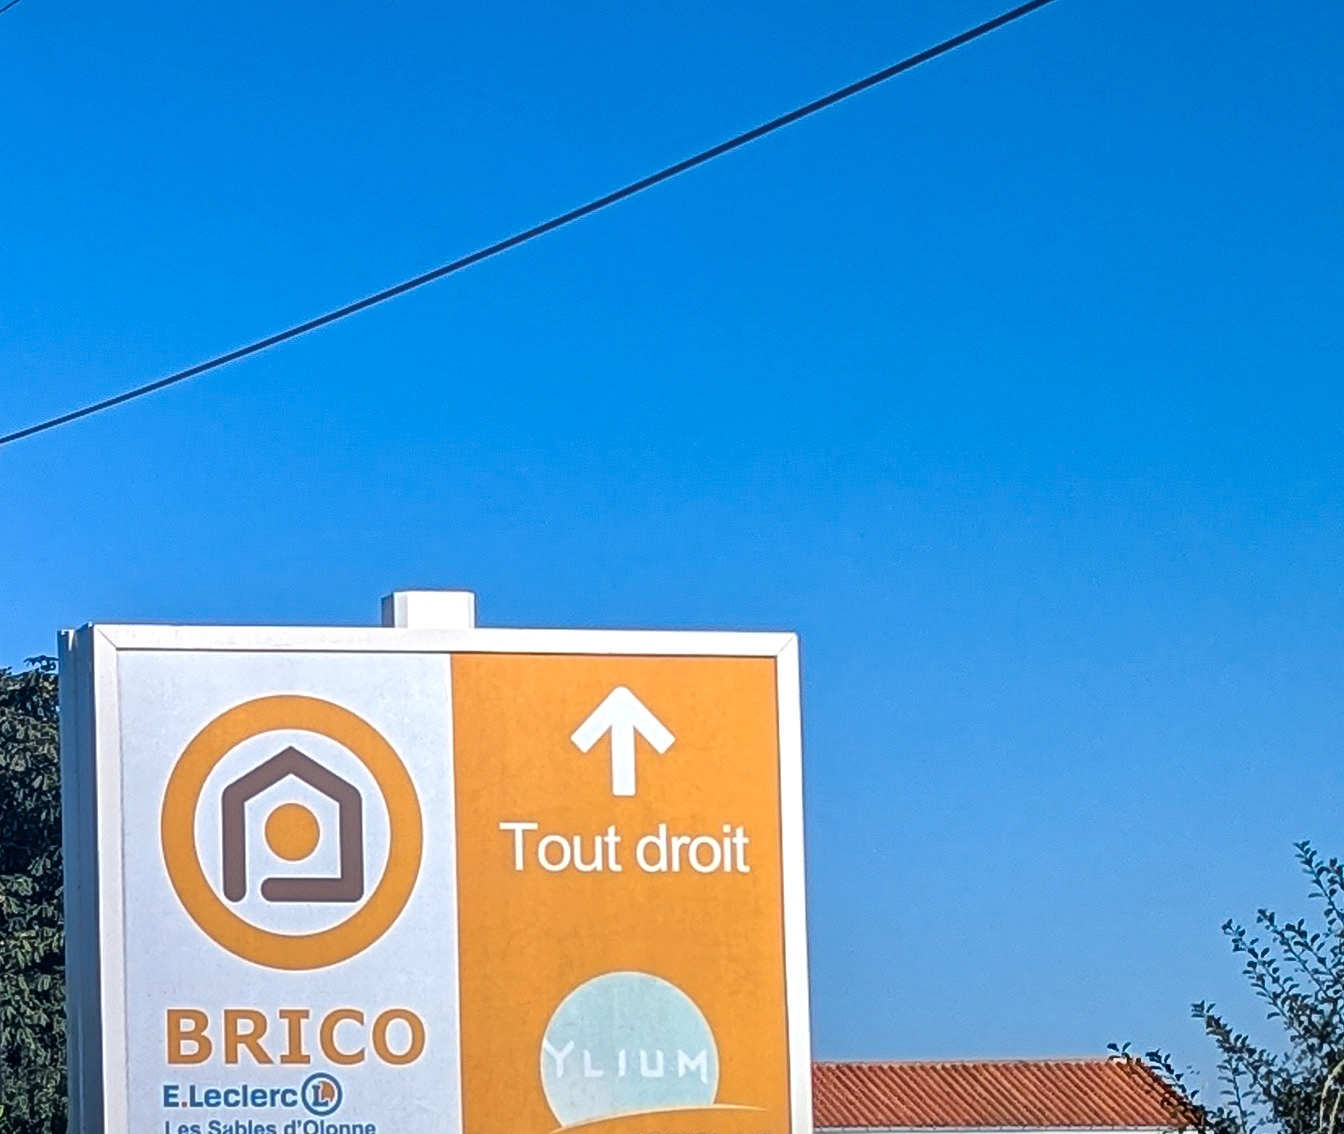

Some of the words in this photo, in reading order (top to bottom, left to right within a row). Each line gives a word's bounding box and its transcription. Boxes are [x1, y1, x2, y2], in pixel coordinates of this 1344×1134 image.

[499, 822, 622, 872] Tout
[635, 823, 751, 873] droit
[166, 1008, 426, 1066] BRICO
[544, 1039, 708, 1085] YLIUM
[163, 1084, 298, 1108] E.Leclerc
